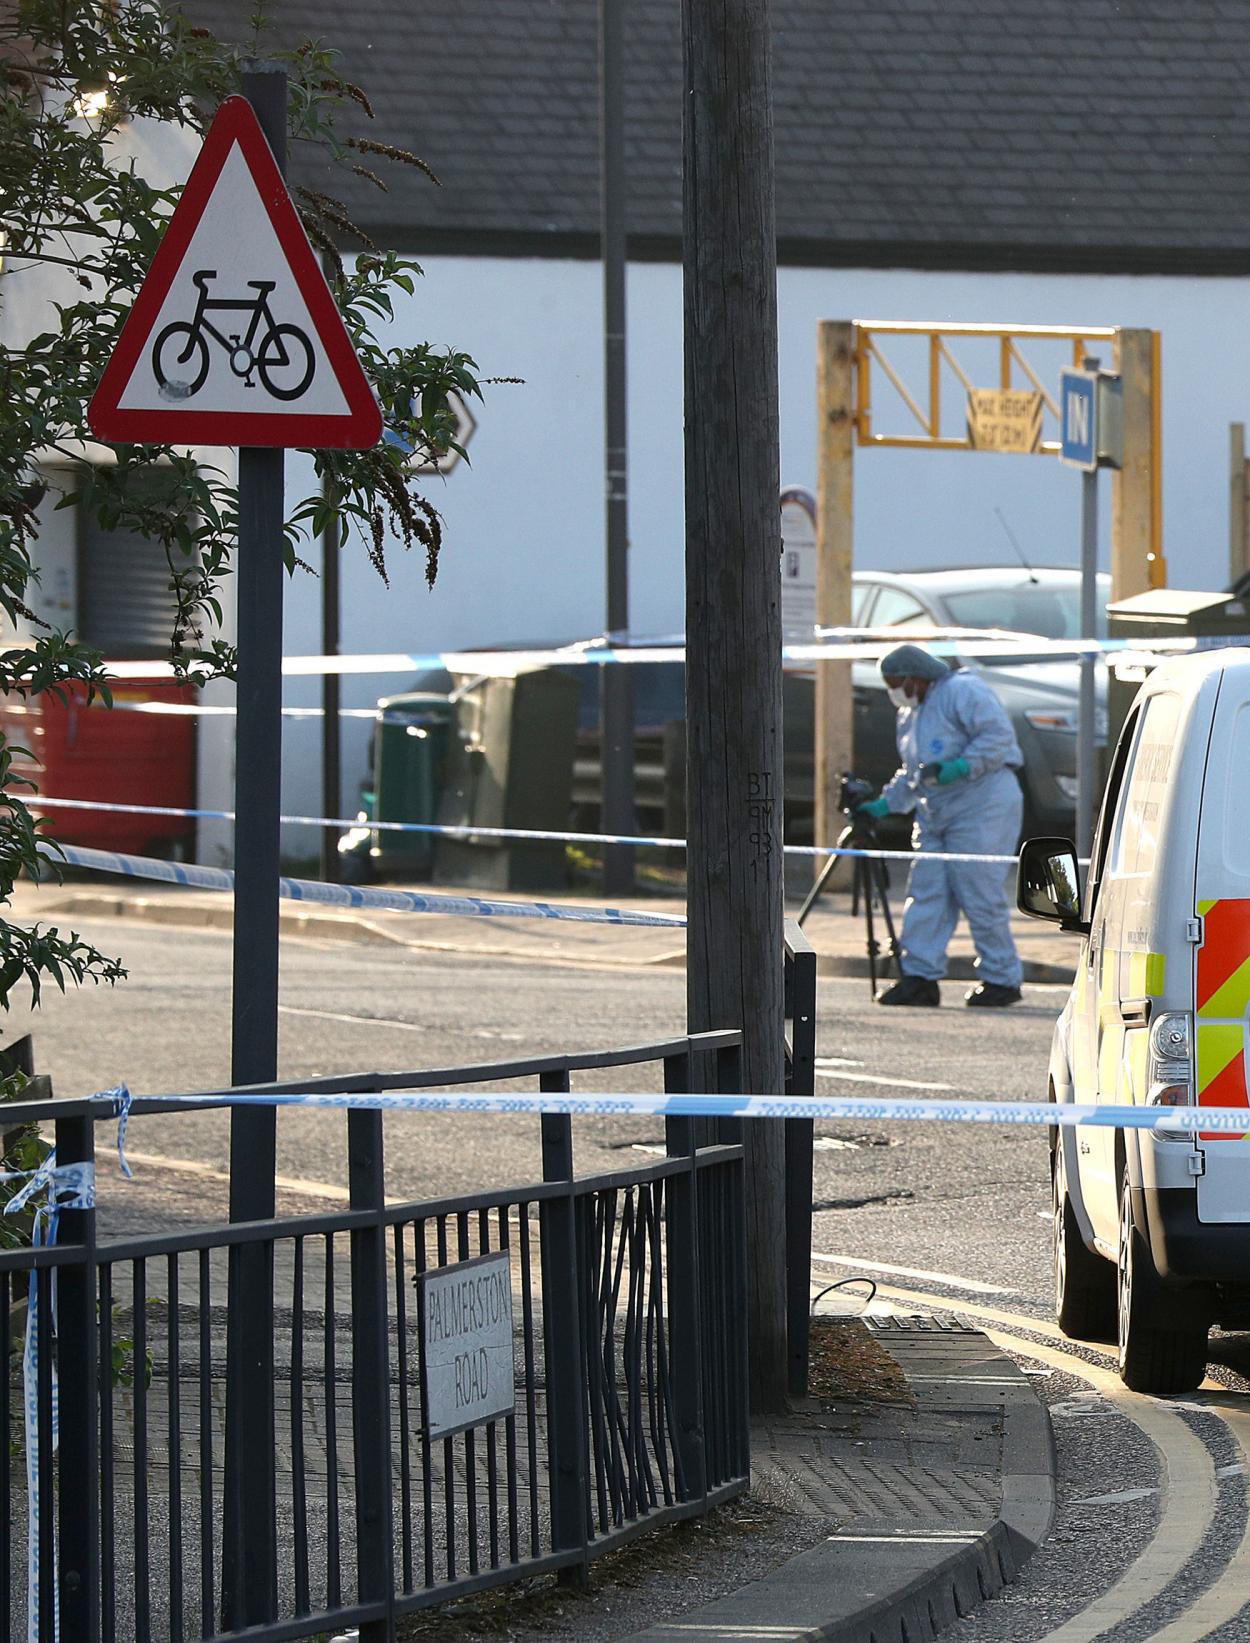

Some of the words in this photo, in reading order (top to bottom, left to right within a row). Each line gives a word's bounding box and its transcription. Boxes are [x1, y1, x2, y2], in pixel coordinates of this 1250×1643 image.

[1067, 391, 1090, 446] IN
[428, 1270, 509, 1343] PALMERSTON
[454, 1348, 489, 1409] ROAD
